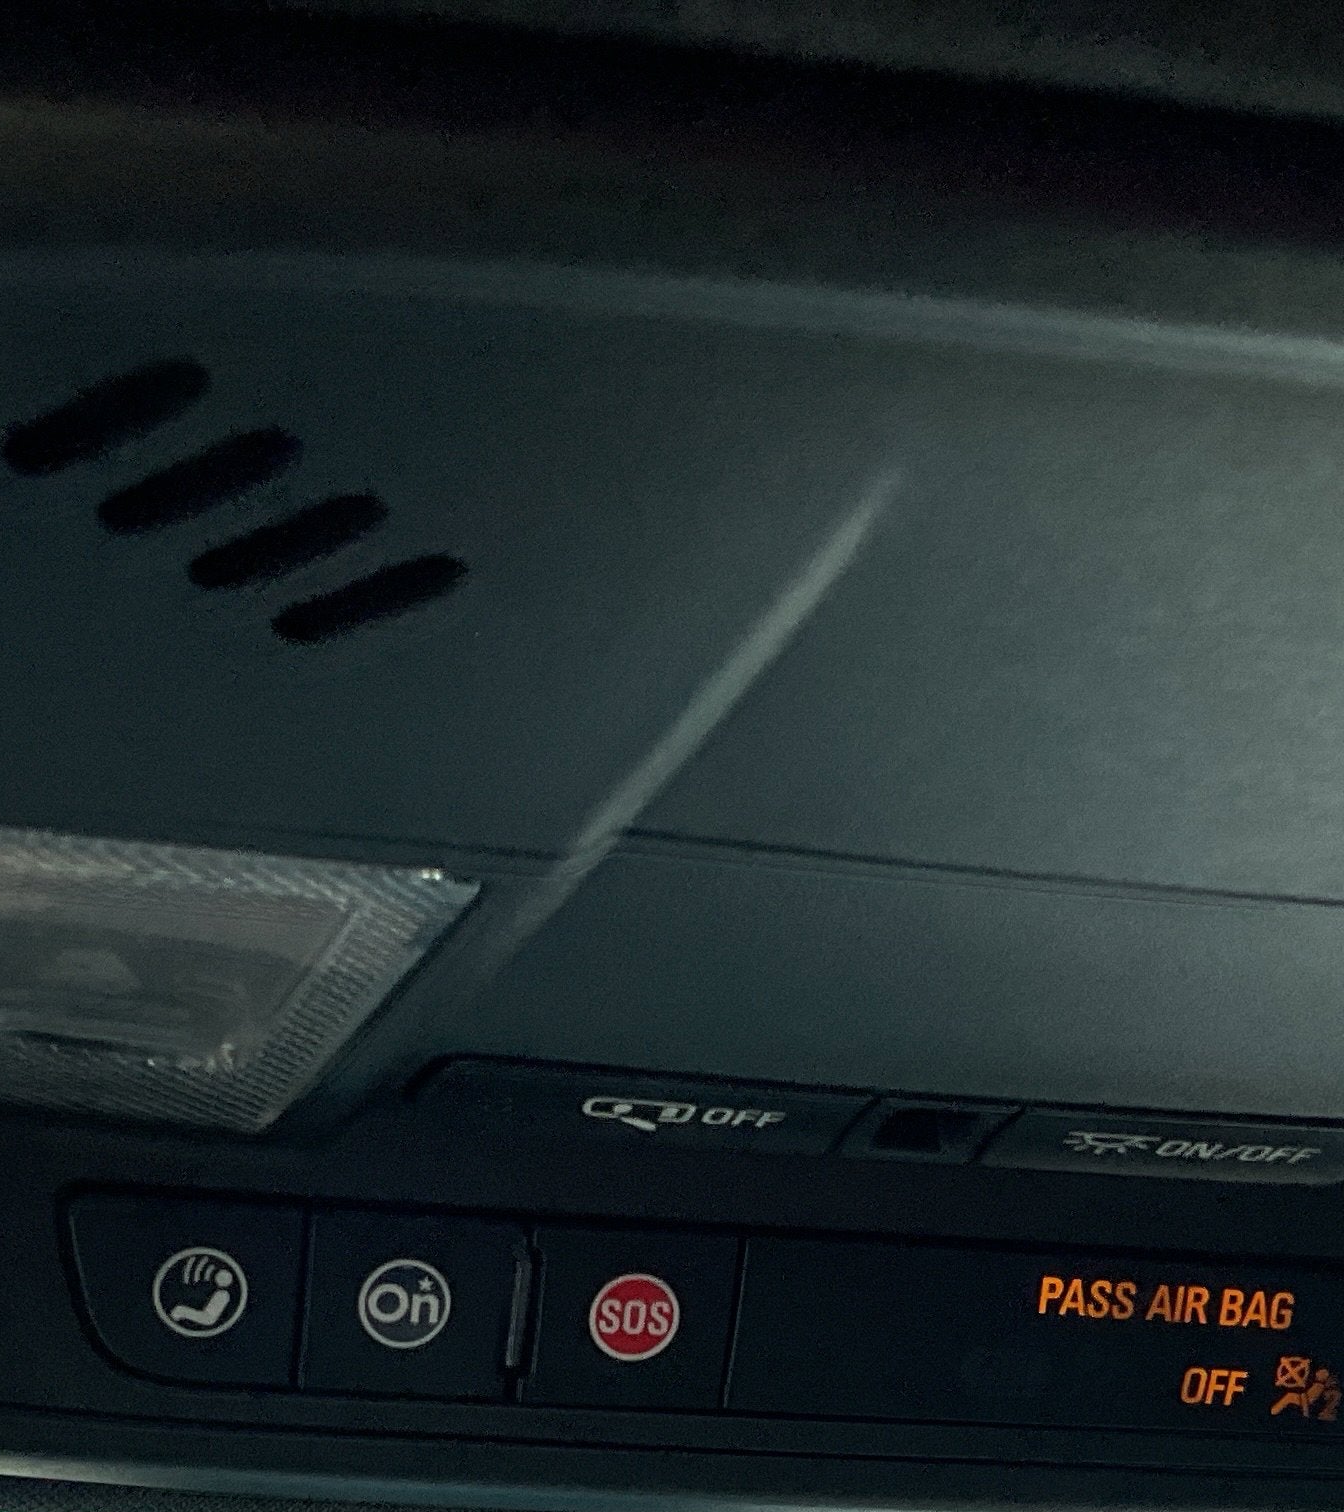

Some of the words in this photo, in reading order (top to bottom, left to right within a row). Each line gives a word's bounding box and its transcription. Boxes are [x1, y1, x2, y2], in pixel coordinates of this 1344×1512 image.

[701, 1106, 787, 1129] OFF
[1156, 1140, 1321, 1165] ON/OFF
[367, 1282, 440, 1326] On
[598, 1298, 672, 1337] SOS
[1037, 1275, 1137, 1320] PASS
[1144, 1284, 1211, 1325] AIR
[1218, 1288, 1296, 1330] BAG
[1179, 1366, 1249, 1407] OFF
